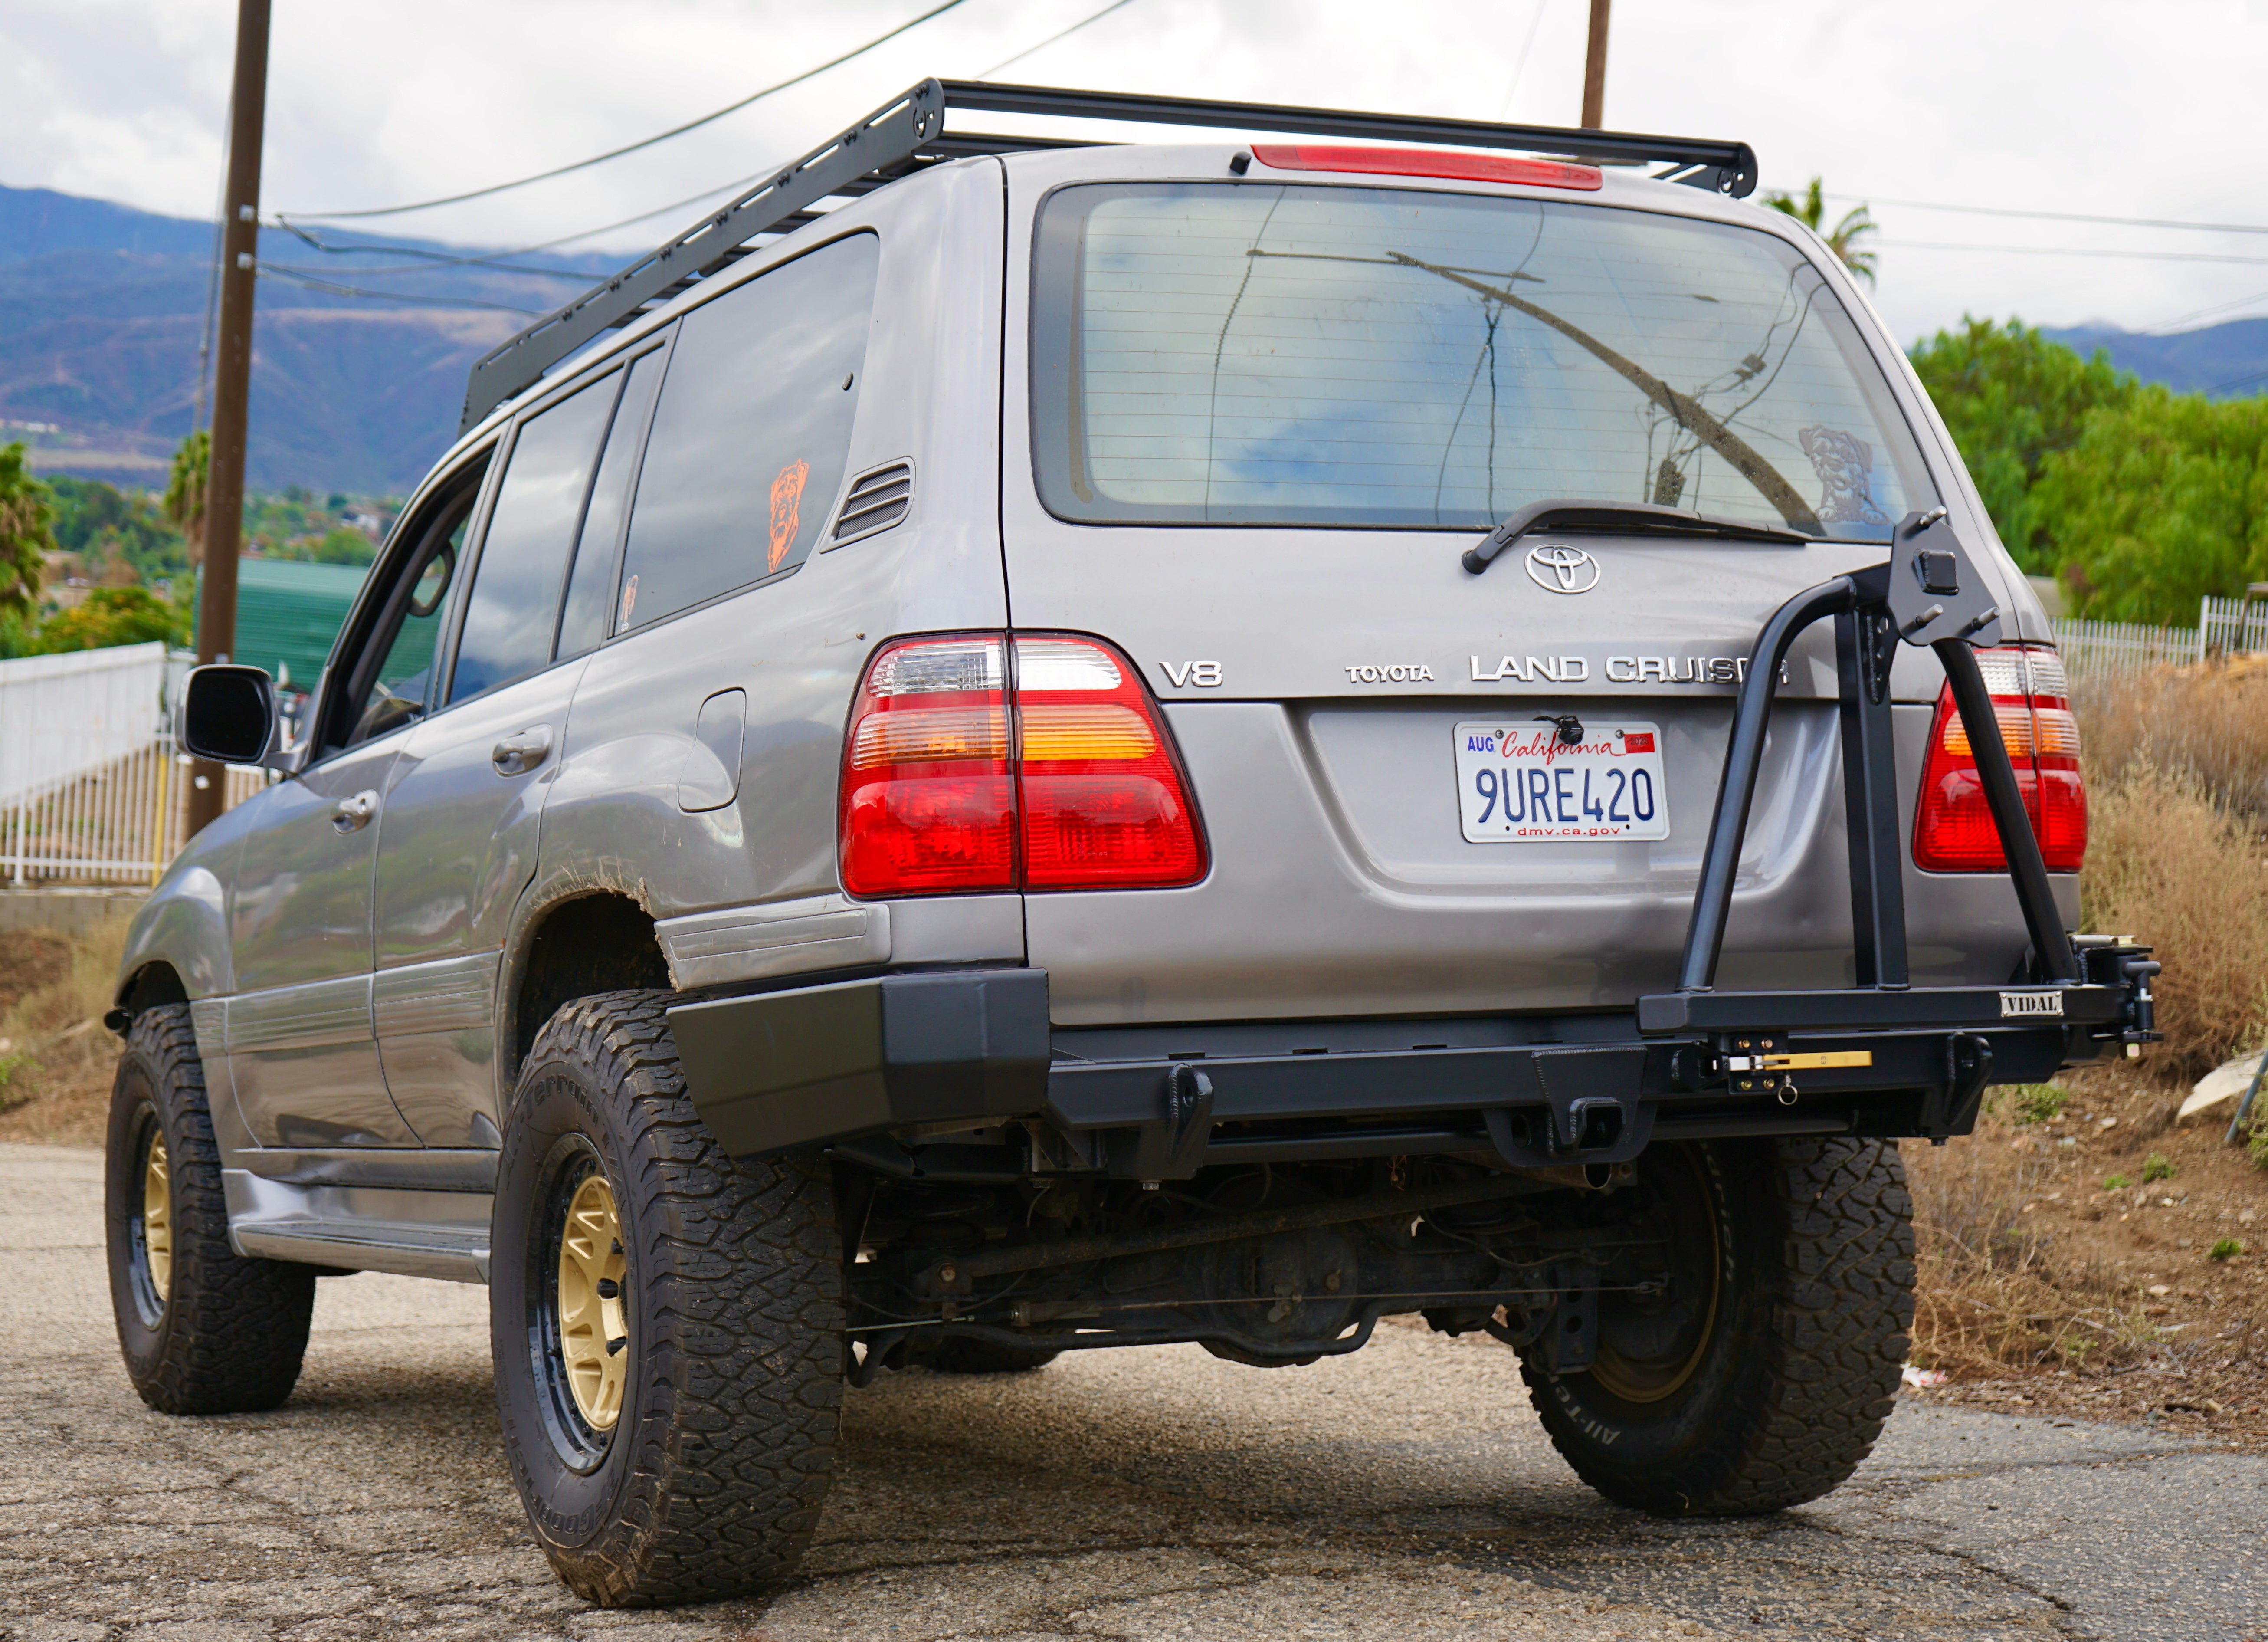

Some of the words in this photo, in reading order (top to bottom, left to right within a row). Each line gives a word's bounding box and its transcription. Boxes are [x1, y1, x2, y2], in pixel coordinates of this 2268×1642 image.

[1159, 660, 1223, 687] V8
[1345, 664, 1434, 683] TOYOTA
[1470, 655, 1590, 681] LAND
[1468, 736, 1495, 752] AUG
[1502, 731, 1626, 766] California
[1475, 768, 1655, 823] 9URE420
[1517, 827, 1621, 837] dmv.ca.gov
[2007, 996, 2057, 1012] VIDAL
